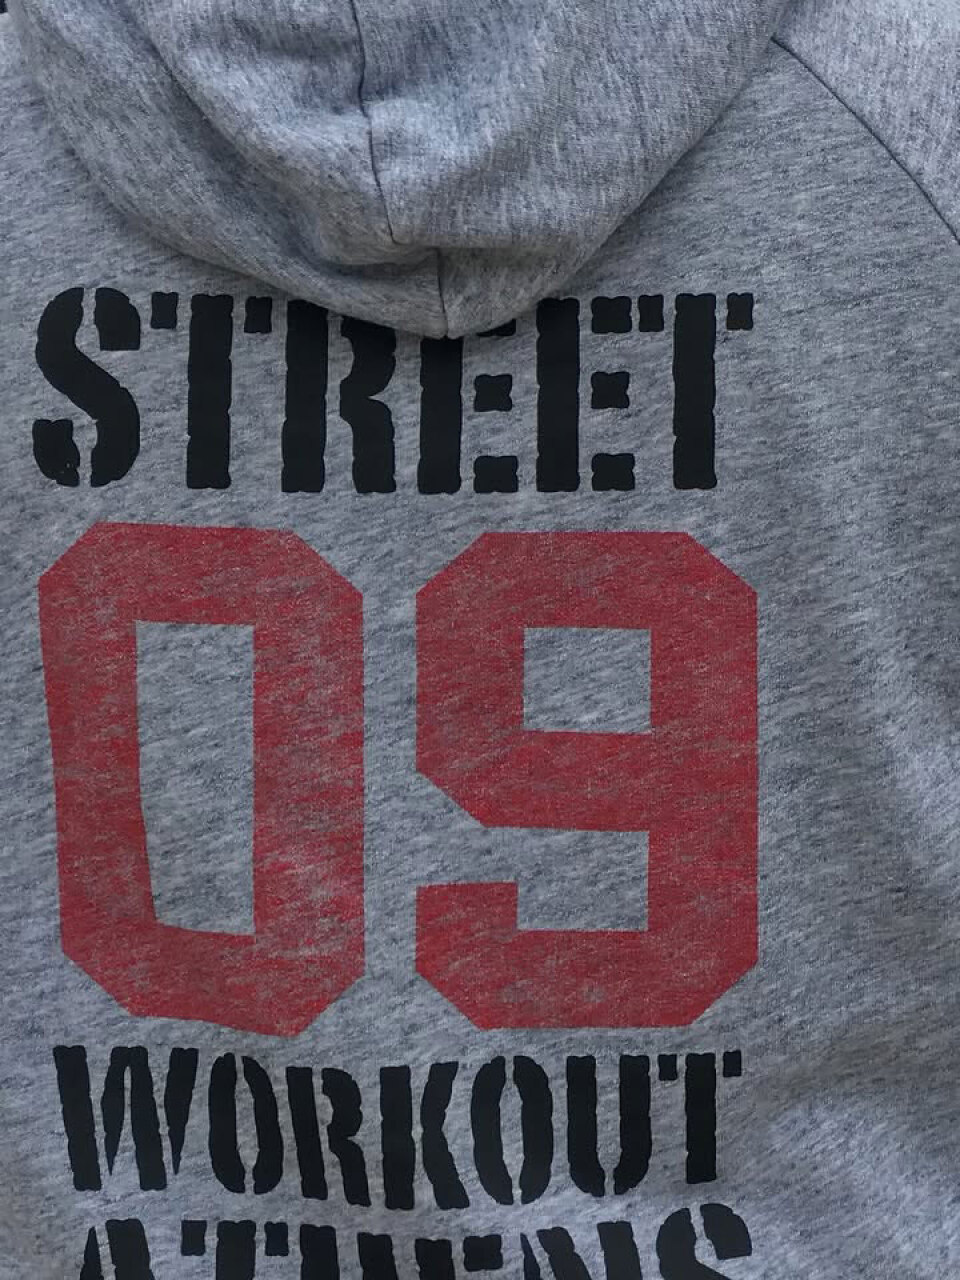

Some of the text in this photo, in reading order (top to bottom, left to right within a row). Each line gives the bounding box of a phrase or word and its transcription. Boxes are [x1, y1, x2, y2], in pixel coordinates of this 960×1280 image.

[33, 287, 754, 493] STREET
[38, 522, 758, 1037] 09
[53, 1045, 741, 1210] WORKOUT
